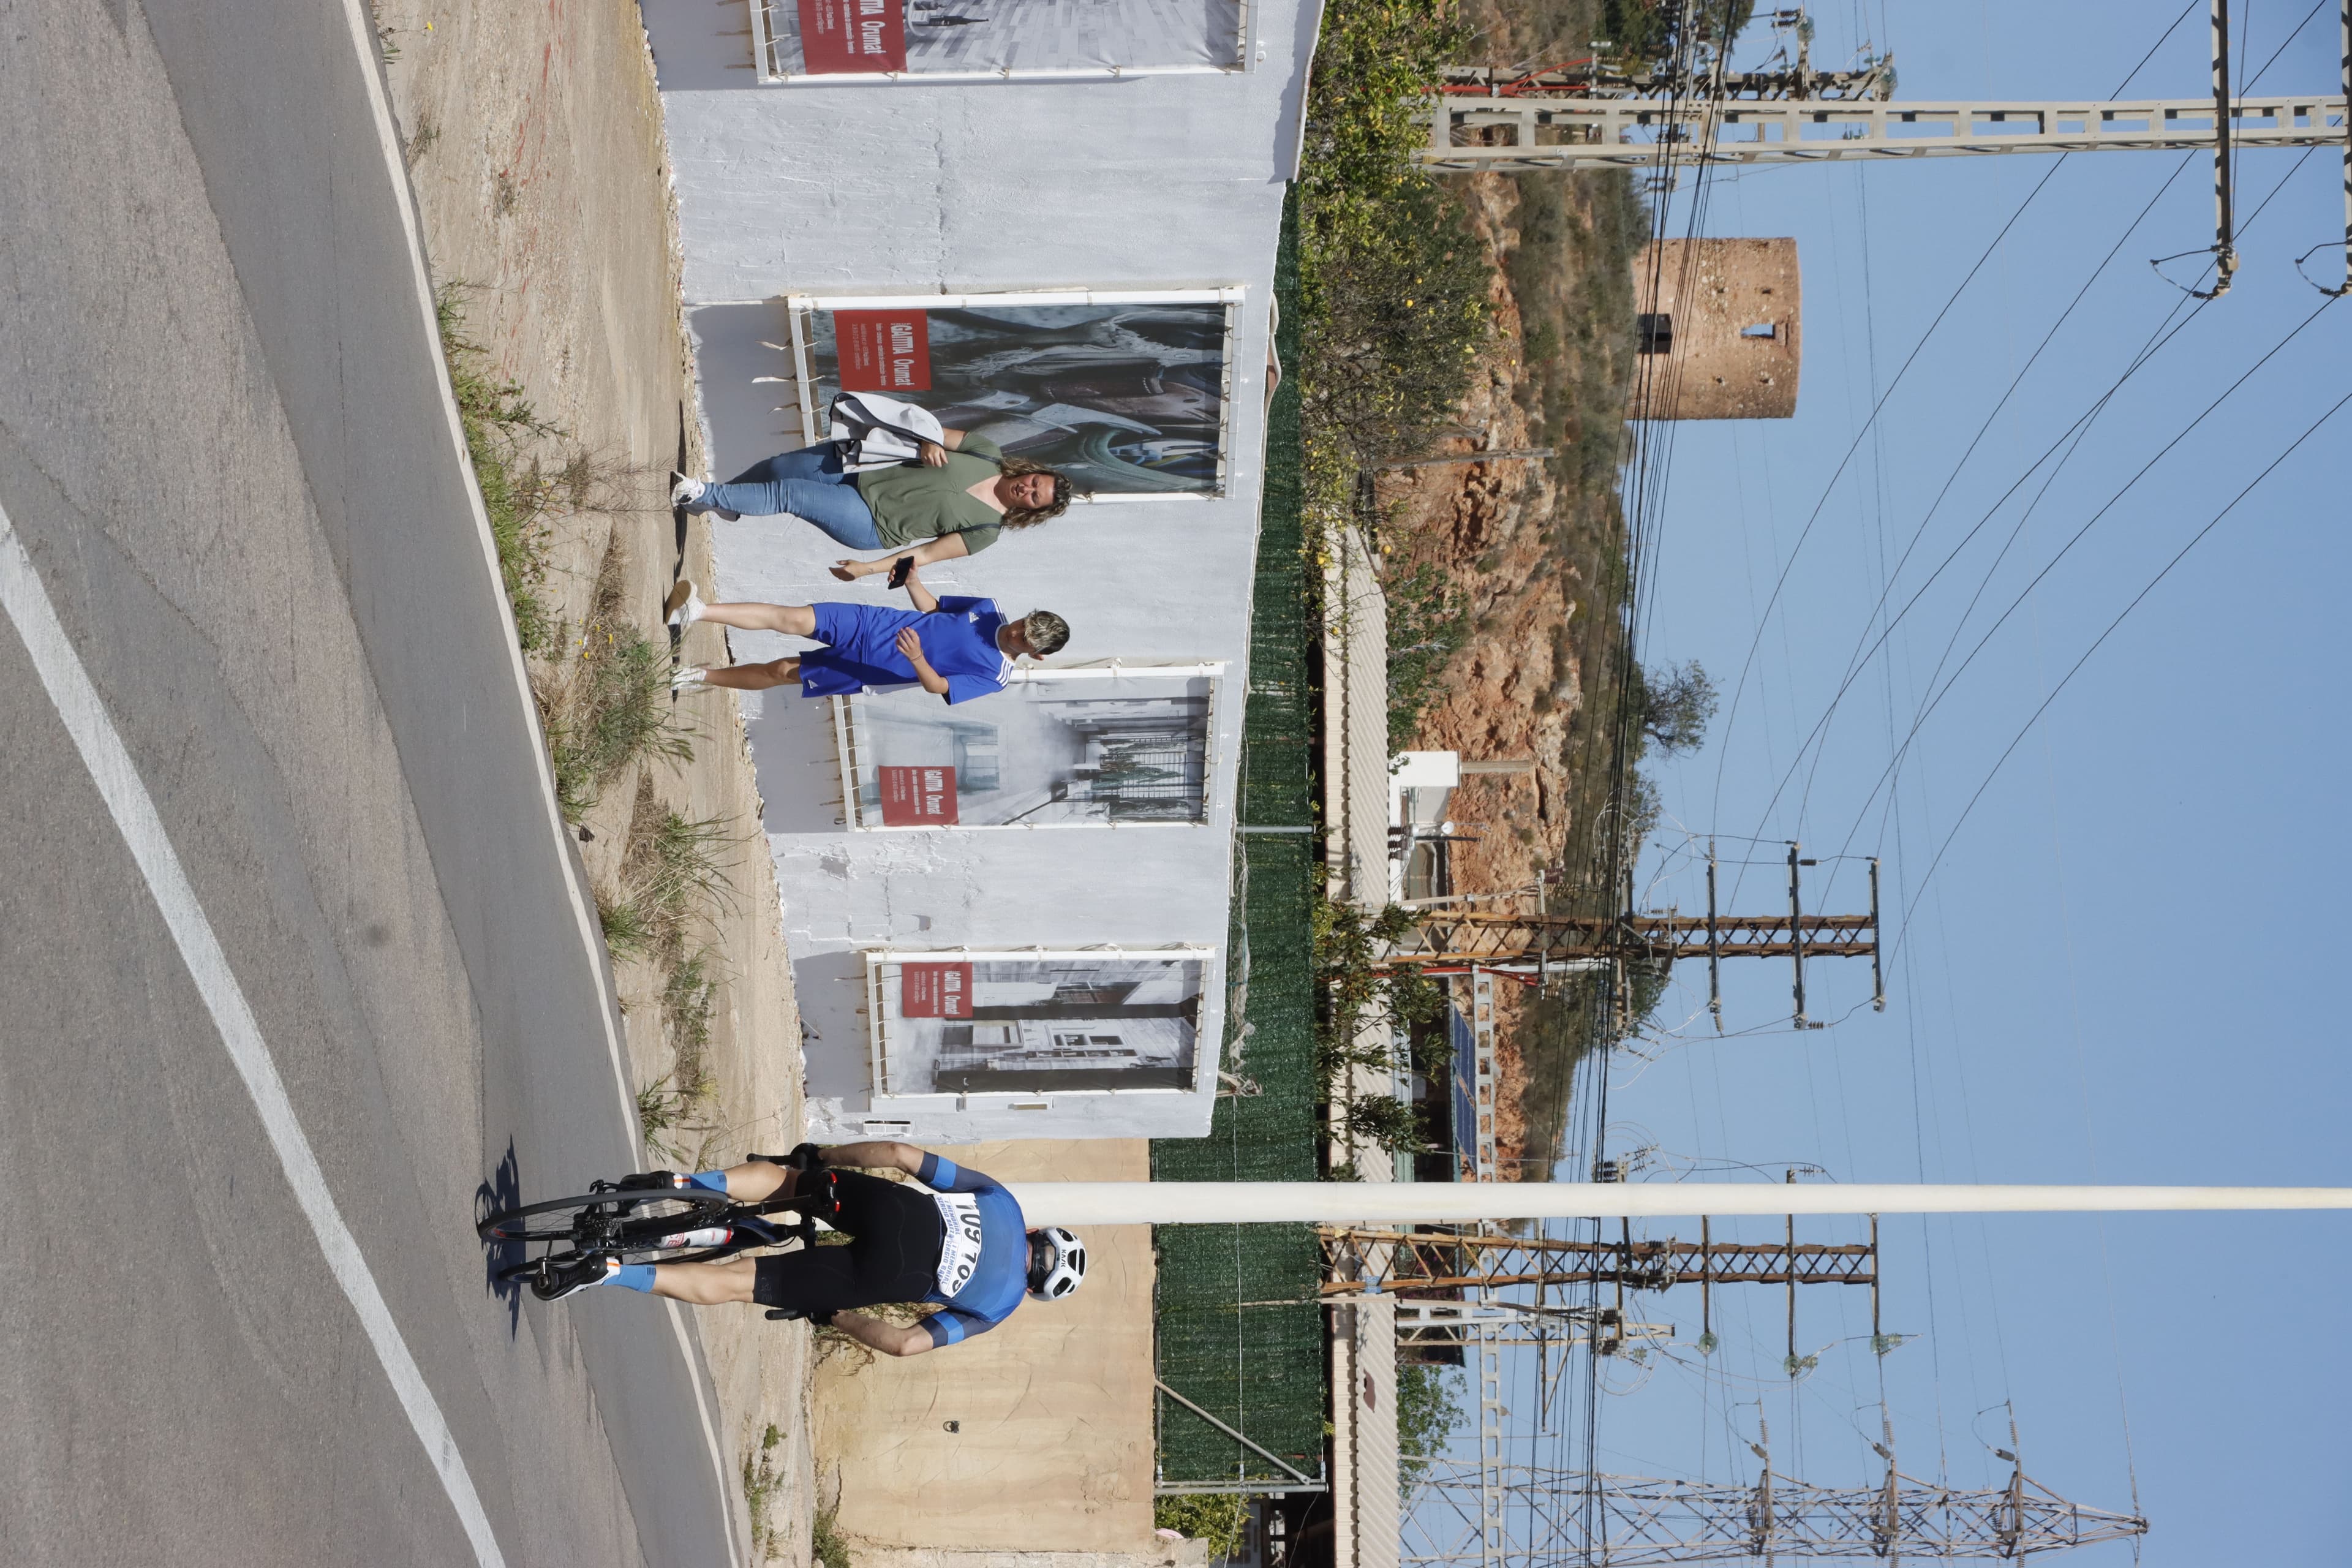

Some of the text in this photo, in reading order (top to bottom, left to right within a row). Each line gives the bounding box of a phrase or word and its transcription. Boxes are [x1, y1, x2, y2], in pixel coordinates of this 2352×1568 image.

[860, 21, 887, 54] Orumat
[890, 325, 914, 355] GAMMA
[892, 359, 915, 386] Orumat
[924, 771, 944, 815] GAMMA Orumat
[944, 972, 962, 1014] GAMMA Orumat
[937, 1197, 949, 1218] SERGIO
[946, 1204, 960, 1235] MEMORIAL
[941, 1250, 956, 1285] MEMORIAL
[943, 1240, 952, 1264] SERGIO
